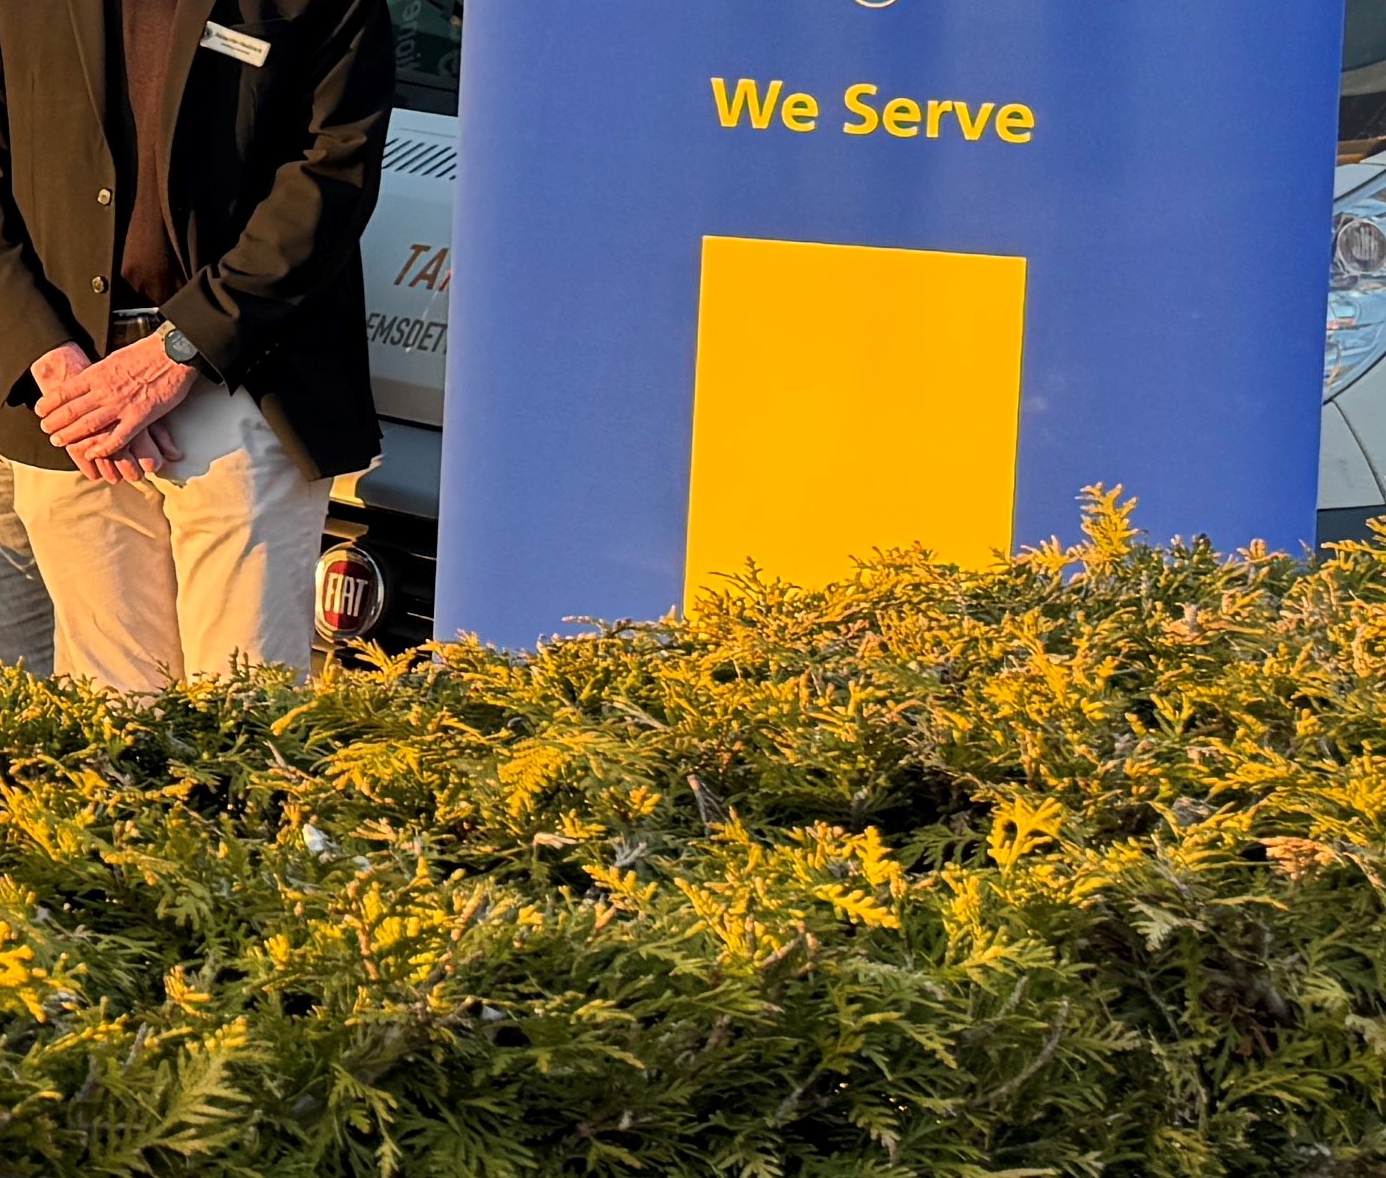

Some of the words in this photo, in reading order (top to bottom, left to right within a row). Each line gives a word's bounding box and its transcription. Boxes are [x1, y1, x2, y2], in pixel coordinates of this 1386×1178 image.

[711, 78, 819, 133] We
[844, 83, 1036, 144] Serve
[367, 311, 448, 355] EMSDET
[324, 572, 369, 617] FIAT
